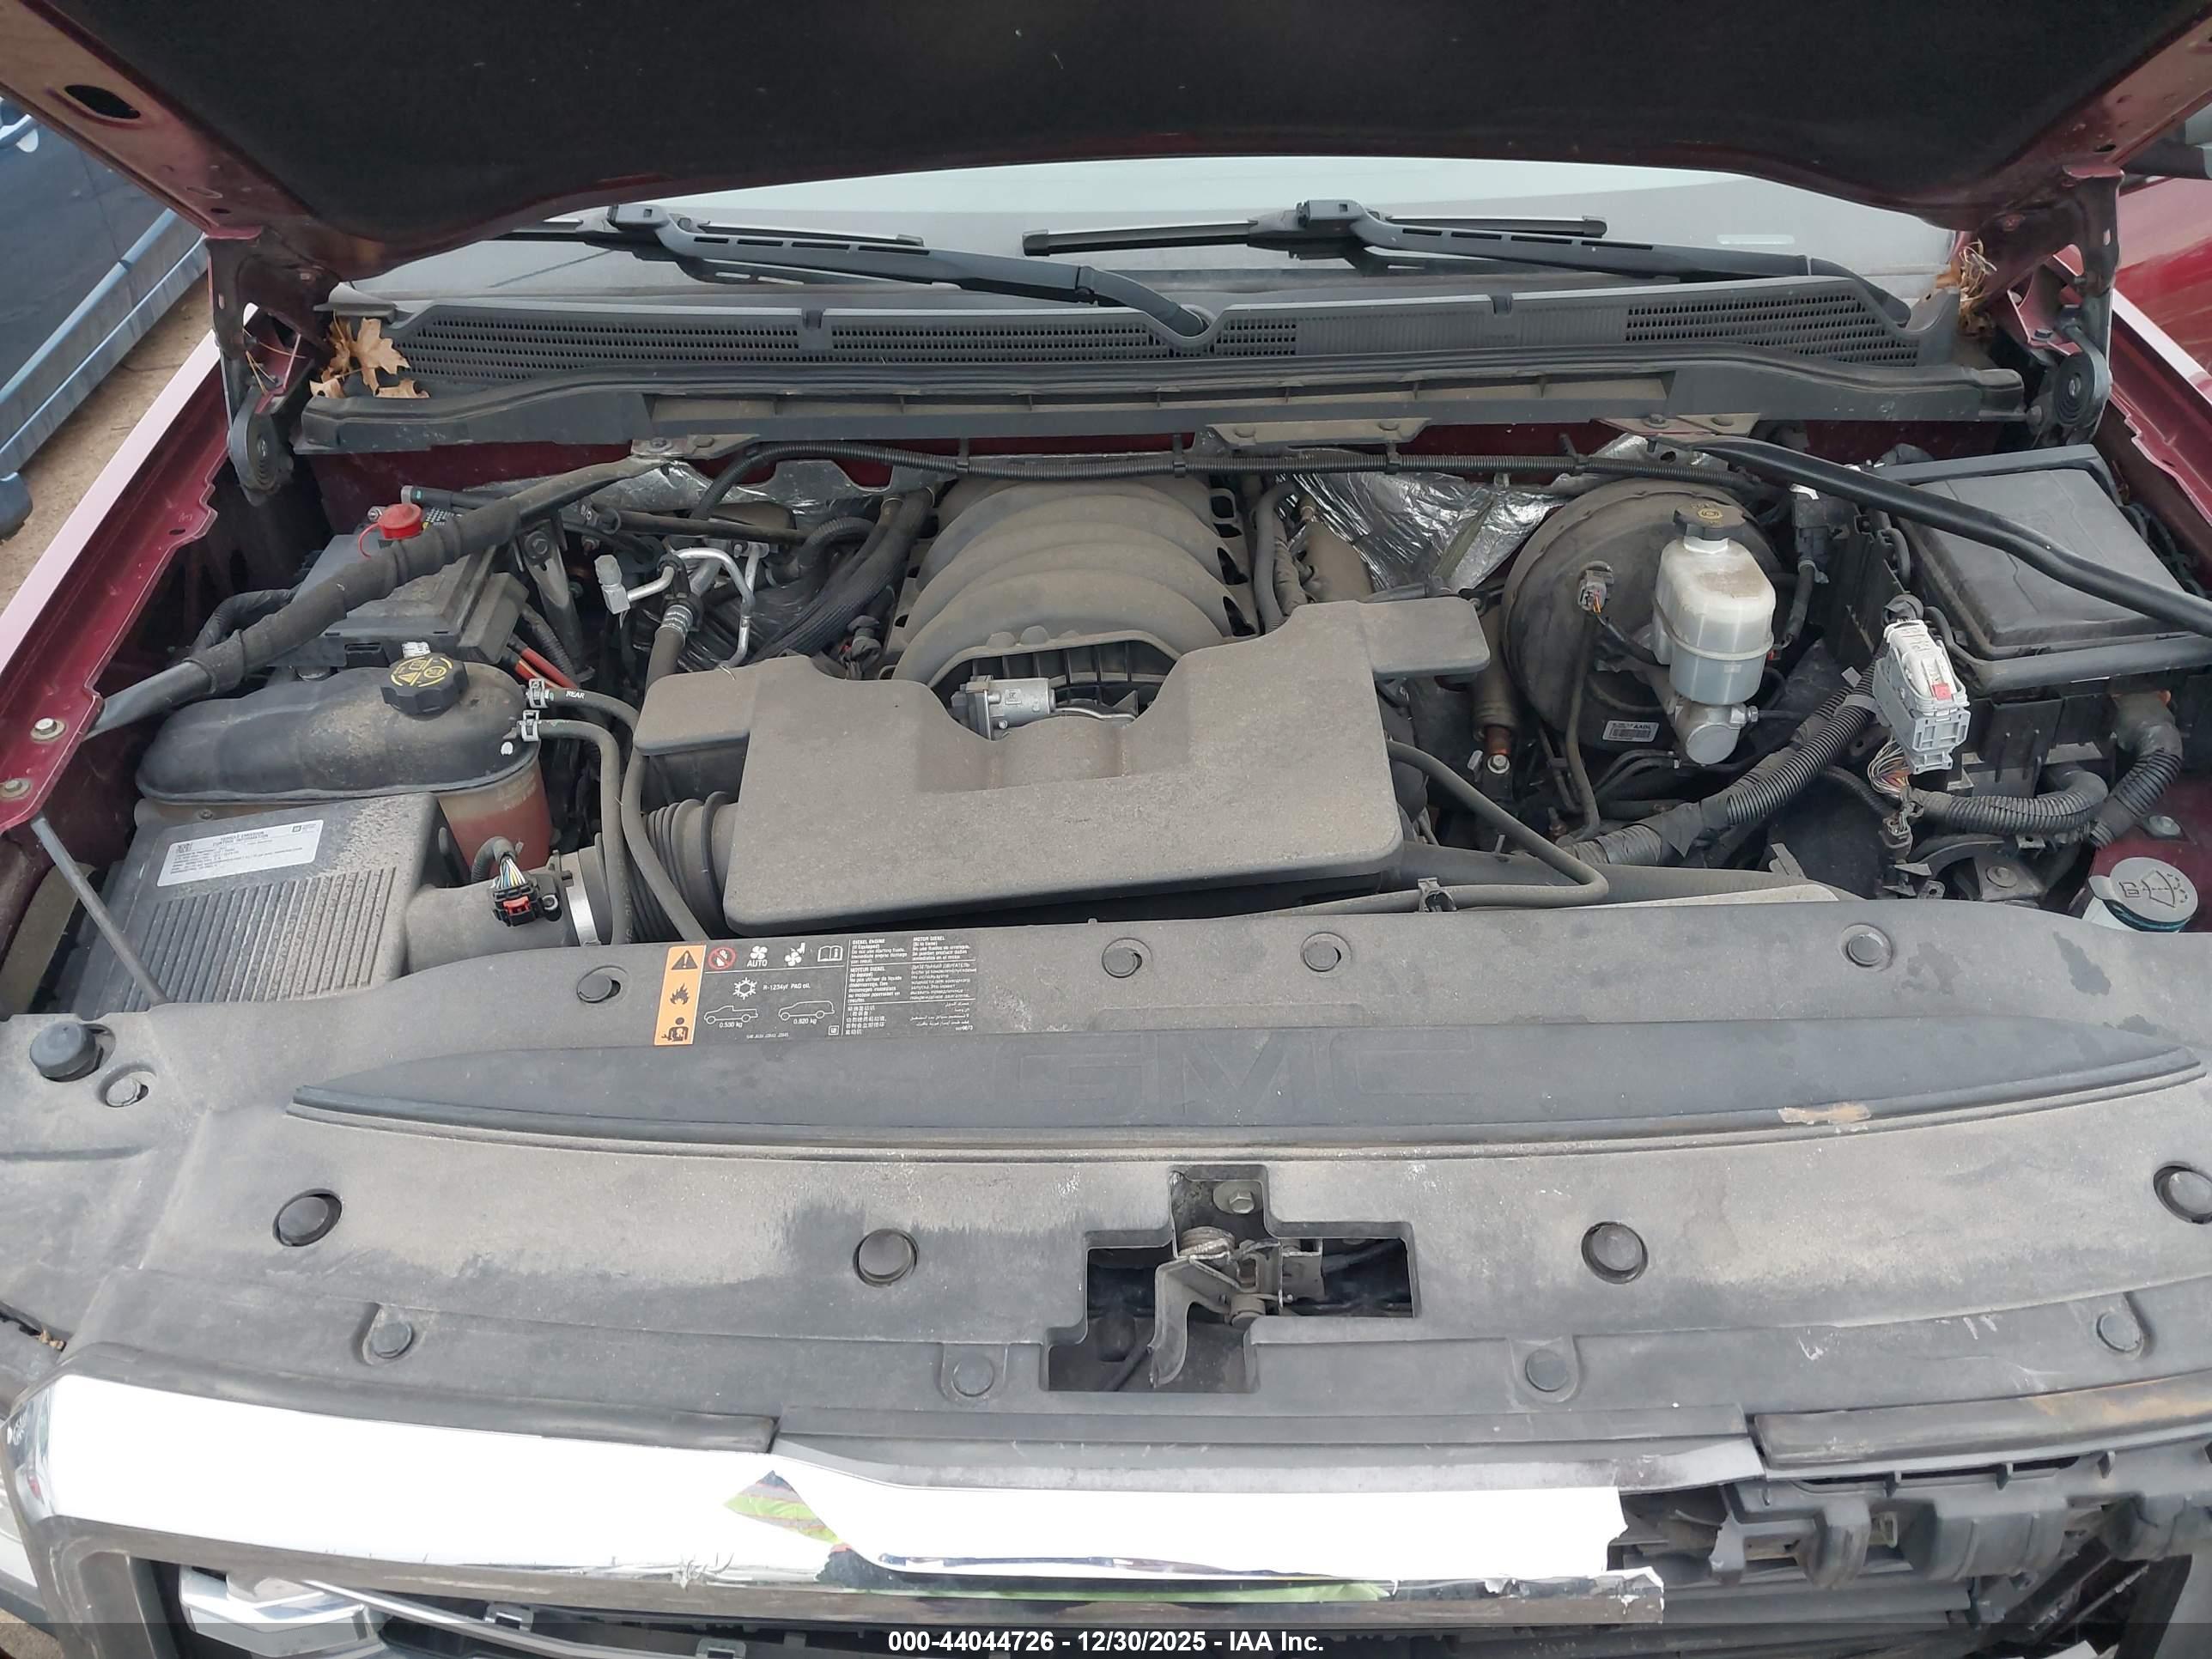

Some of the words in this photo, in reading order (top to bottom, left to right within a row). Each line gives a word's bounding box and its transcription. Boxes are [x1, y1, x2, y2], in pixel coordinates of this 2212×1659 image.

[565, 690, 585, 700] REAR
[746, 959, 768, 968] AUTO
[994, 1030, 1477, 1121] GMC
